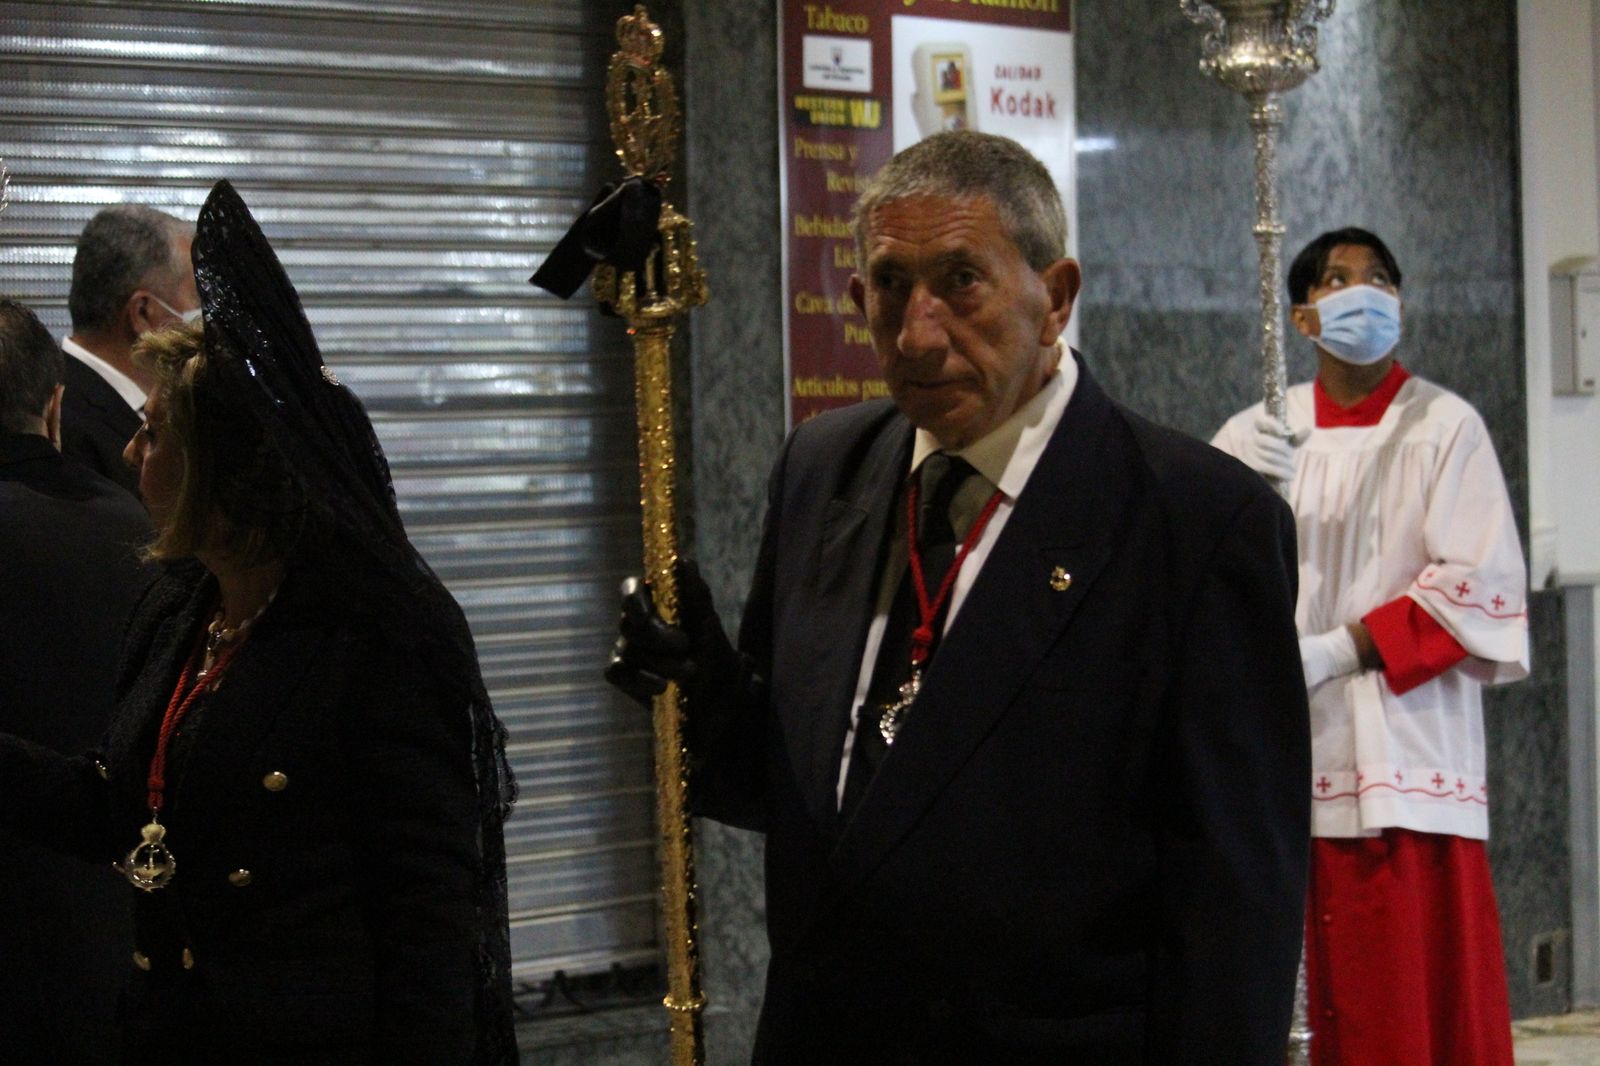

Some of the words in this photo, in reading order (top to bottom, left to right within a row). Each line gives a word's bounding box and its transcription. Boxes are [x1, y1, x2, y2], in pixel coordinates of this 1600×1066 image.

[804, 5, 870, 33] Tabaco
[994, 63, 1042, 81] CALIDAD
[990, 80, 1056, 119] Kodak
